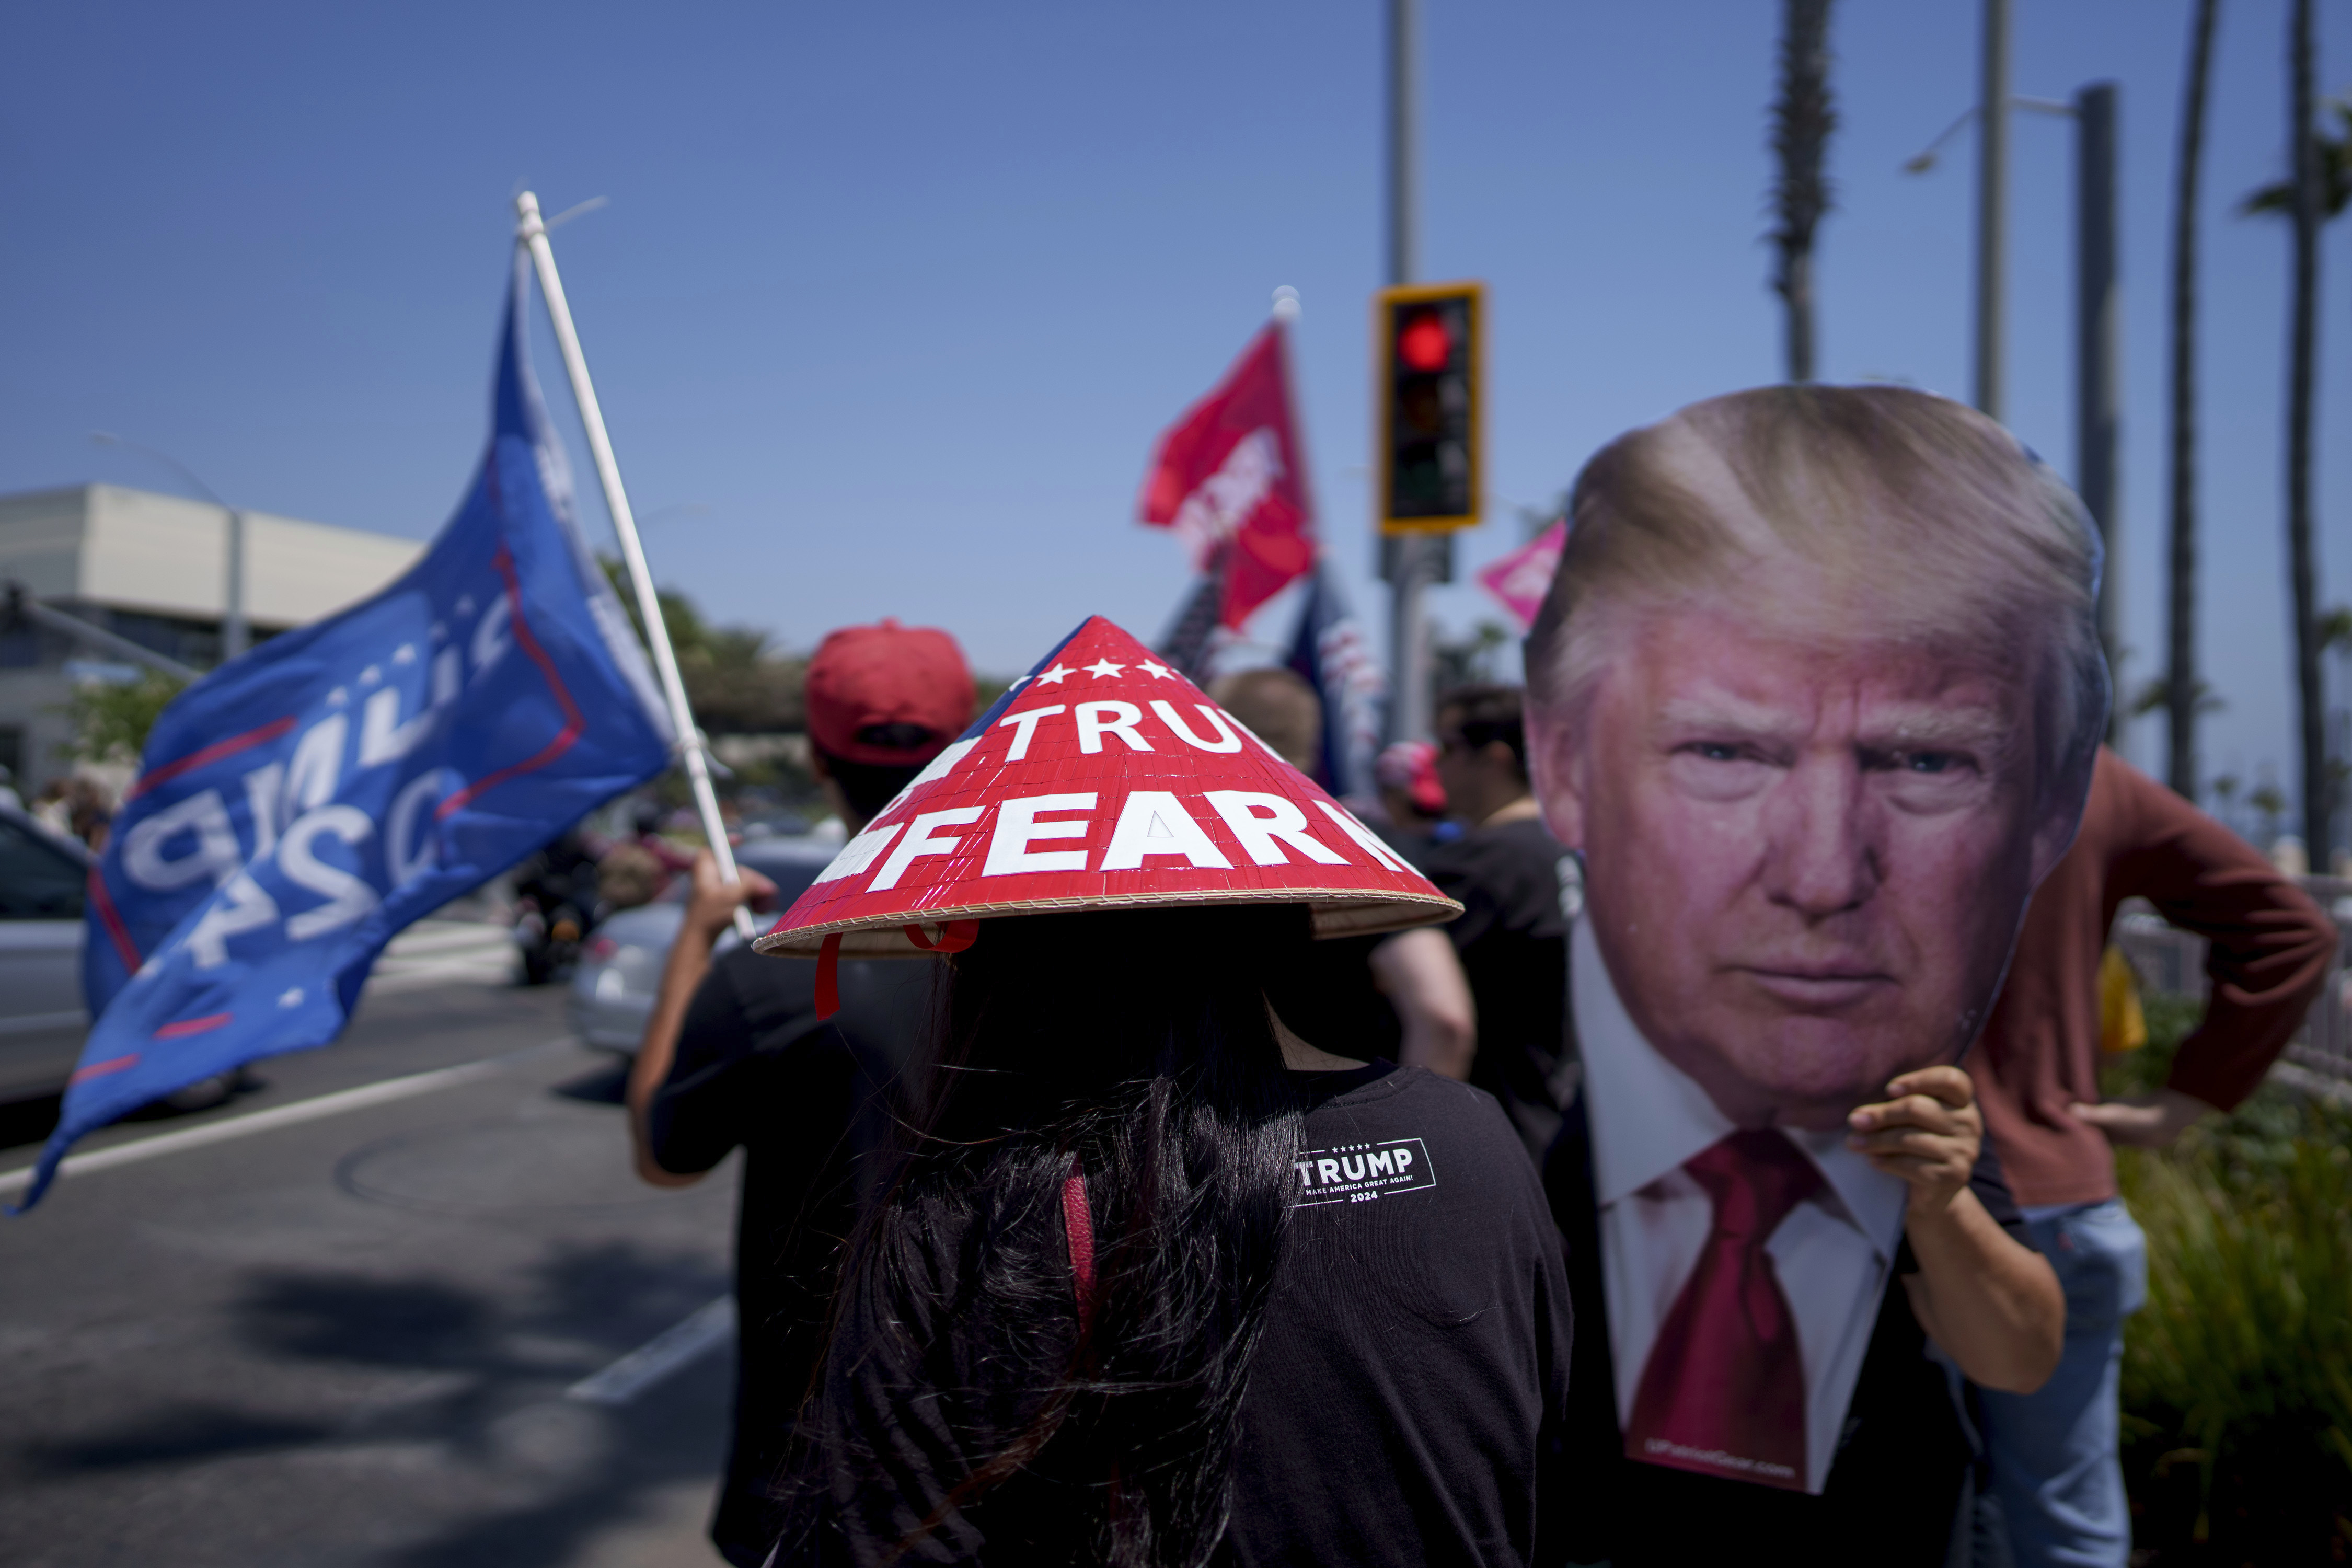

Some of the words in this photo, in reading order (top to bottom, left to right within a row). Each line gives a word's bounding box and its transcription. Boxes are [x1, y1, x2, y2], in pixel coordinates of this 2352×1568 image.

[999, 700, 1286, 763] TRU
[865, 790, 1352, 894] FEAR
[1295, 1148, 1412, 1186] TRUMP
[1330, 1183, 1362, 1193] AMERICA
[1365, 1179, 1387, 1188] GREAT
[1390, 1175, 1413, 1184] AGAIN!
[1351, 1191, 1378, 1203] 2024
